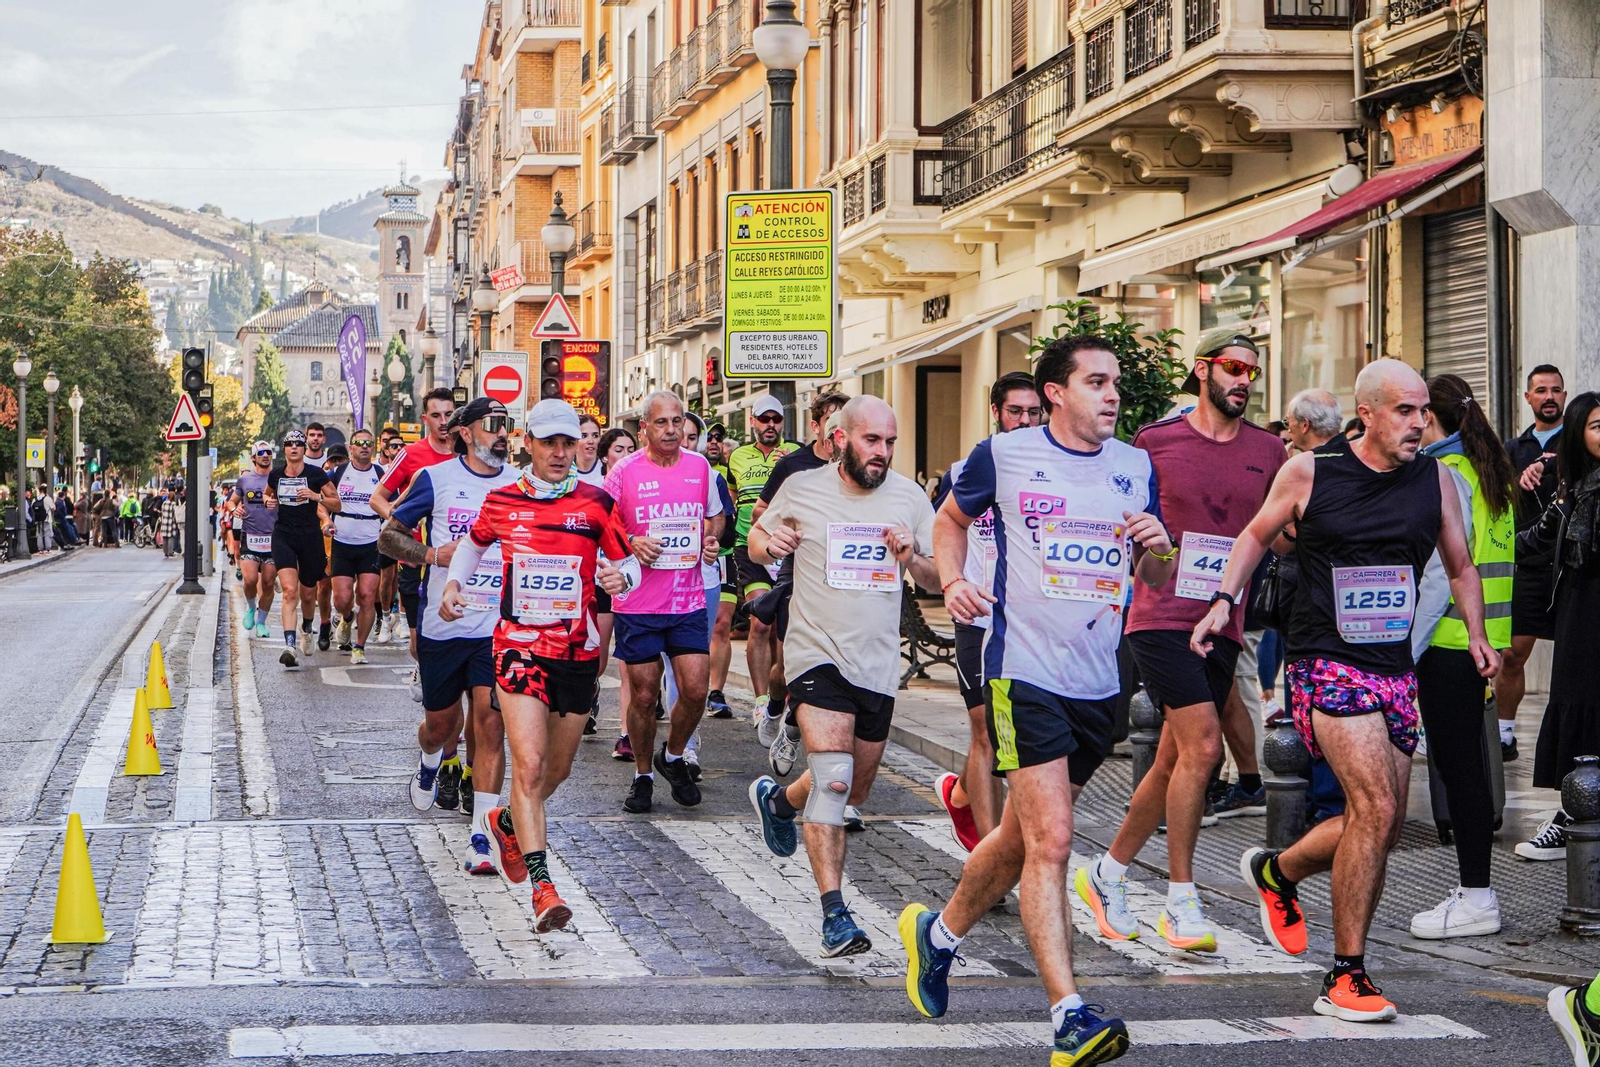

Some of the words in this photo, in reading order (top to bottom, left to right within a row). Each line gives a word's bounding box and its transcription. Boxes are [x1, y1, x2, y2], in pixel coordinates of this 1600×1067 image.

[755, 200, 824, 214] ATENCIÓN
[764, 216, 816, 226] CONTROL
[756, 230, 770, 238] DE
[772, 228, 824, 238] ACCESOS
[735, 252, 766, 262] ACCESO
[769, 251, 824, 260] RESTRINGIDO
[735, 268, 757, 277] CALLE
[759, 267, 782, 276] REYES
[784, 264, 824, 276] CATÓLICOS
[638, 480, 659, 491] ABB
[1023, 498, 1064, 514] 10ª
[1061, 522, 1113, 531] CARRERA
[842, 544, 887, 561] 223
[1046, 543, 1121, 567] 1000
[1193, 556, 1228, 573] 44
[520, 575, 575, 590] 1352
[1344, 591, 1406, 609] 1253
